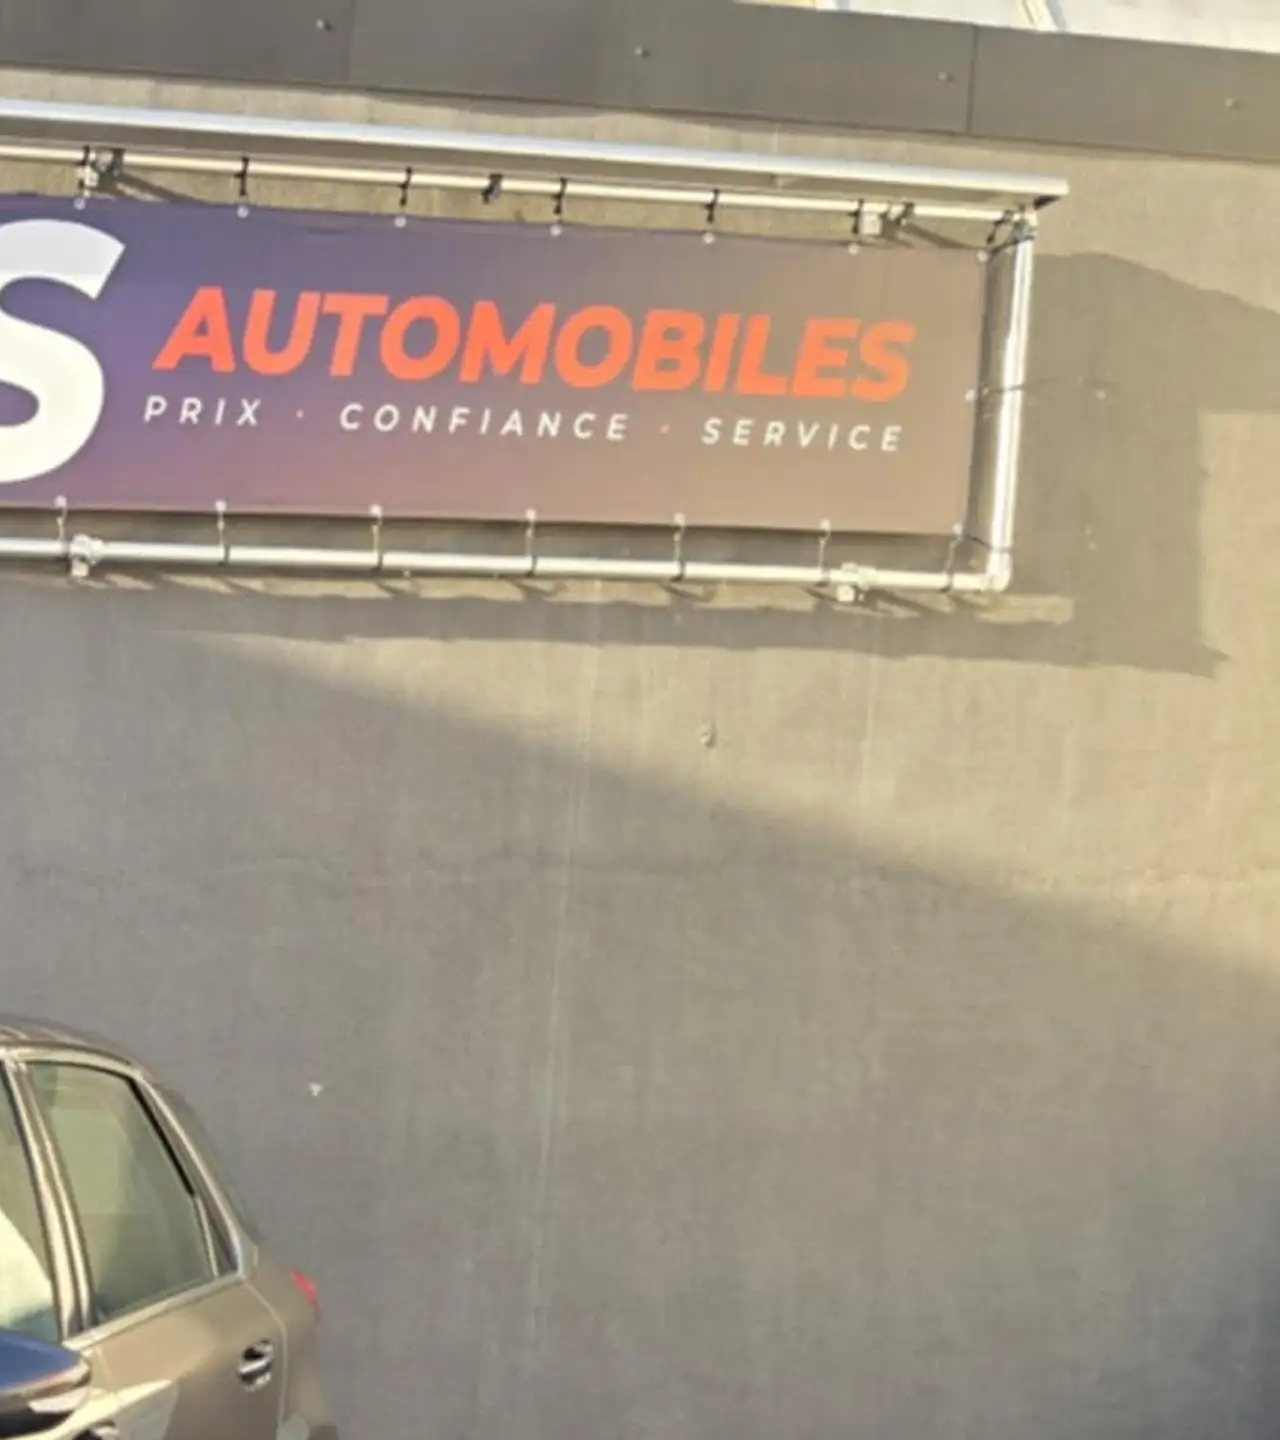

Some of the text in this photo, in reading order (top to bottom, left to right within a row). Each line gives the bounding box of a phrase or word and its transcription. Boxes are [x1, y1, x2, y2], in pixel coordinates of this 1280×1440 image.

[151, 284, 917, 402] AUTOMOBILES
[143, 395, 904, 453] PRIX CONFIANCE SERVICE
